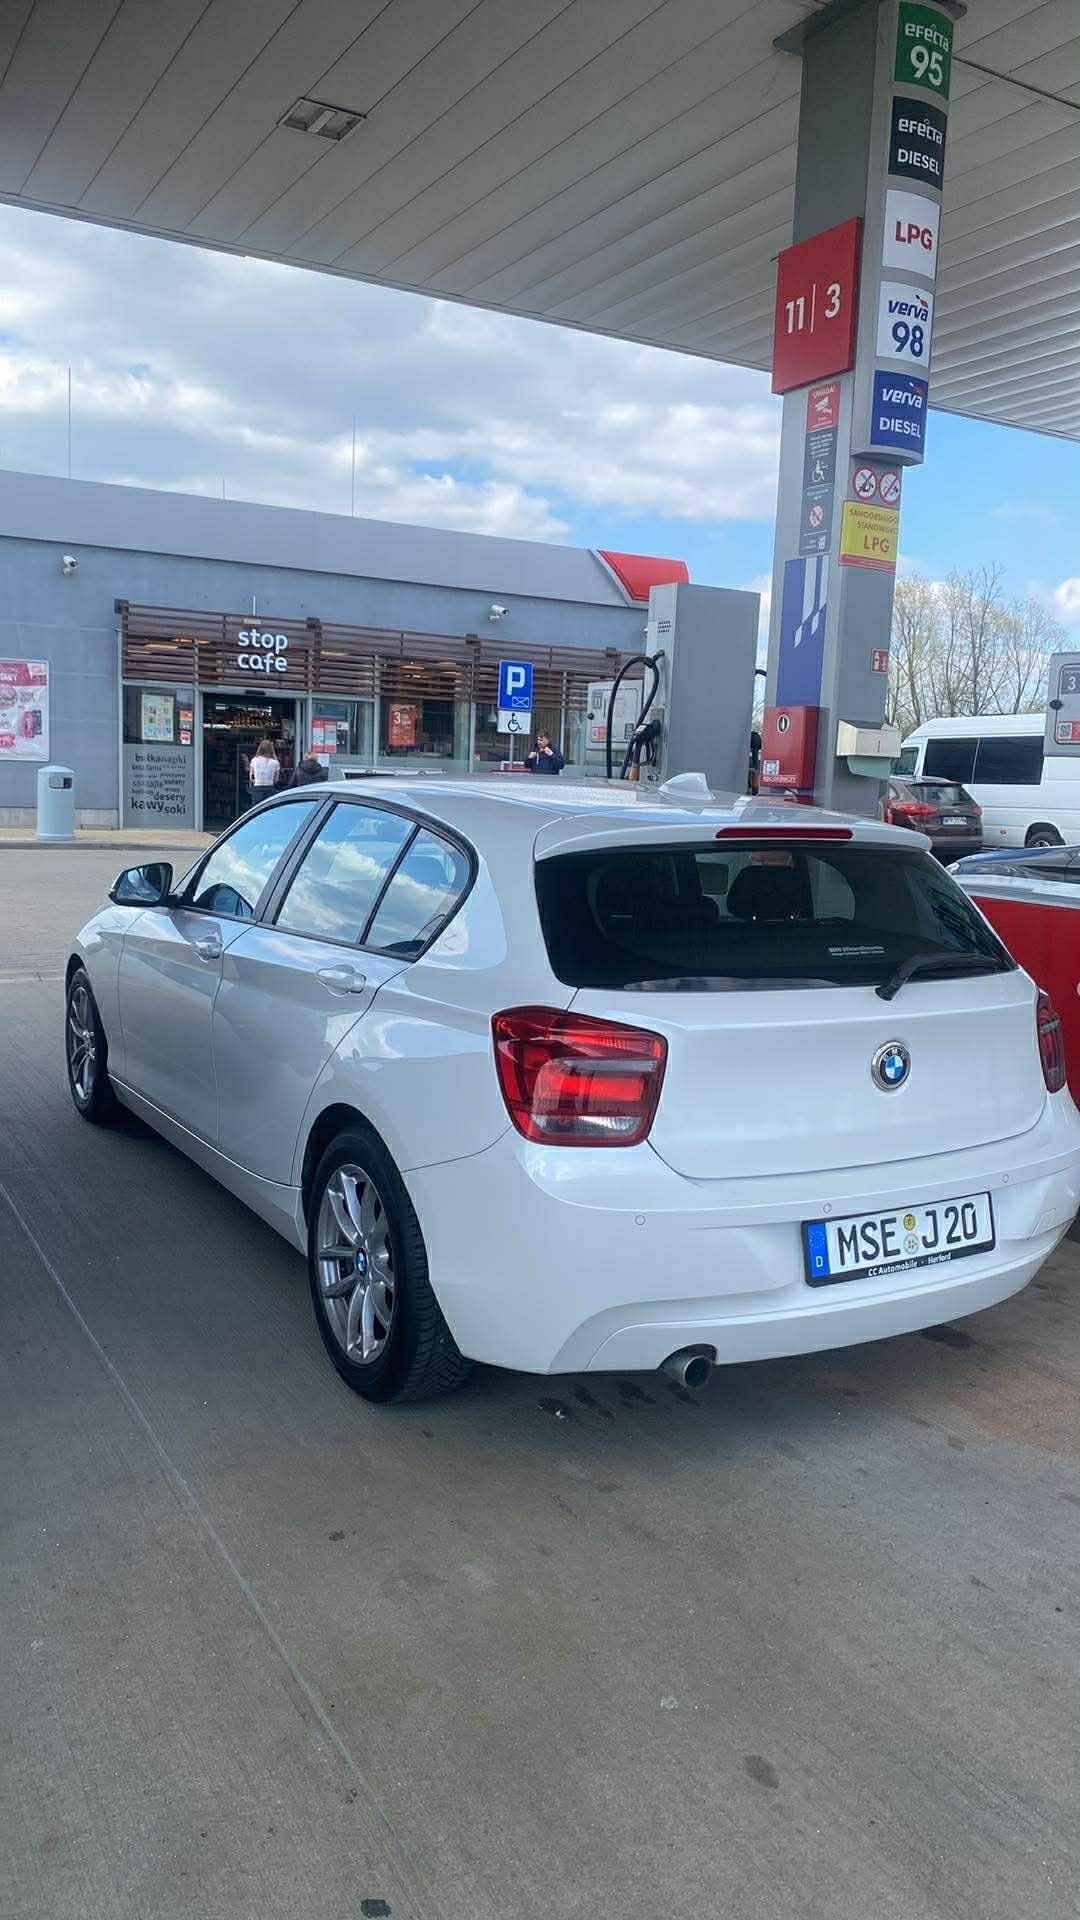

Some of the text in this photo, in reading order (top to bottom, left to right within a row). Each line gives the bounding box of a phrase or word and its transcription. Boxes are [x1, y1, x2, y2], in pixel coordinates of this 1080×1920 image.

[910, 45, 944, 86] 95
[897, 149, 941, 176] DIESEL
[895, 221, 933, 251] LPG
[785, 283, 841, 334] 11 3
[888, 300, 930, 322] verva
[892, 321, 924, 358] 98
[882, 388, 923, 409] verva
[880, 416, 921, 438] DIESEL
[863, 534, 890, 553] LPG
[238, 628, 289, 655] stop
[238, 652, 288, 673] cafe
[506, 665, 526, 696] P
[1067, 676, 1077, 690] 3
[131, 797, 165, 813] kawy
[154, 791, 186, 803] desery
[164, 803, 186, 815] soki
[837, 1217, 900, 1266] MSE
[816, 1255, 824, 1268] D
